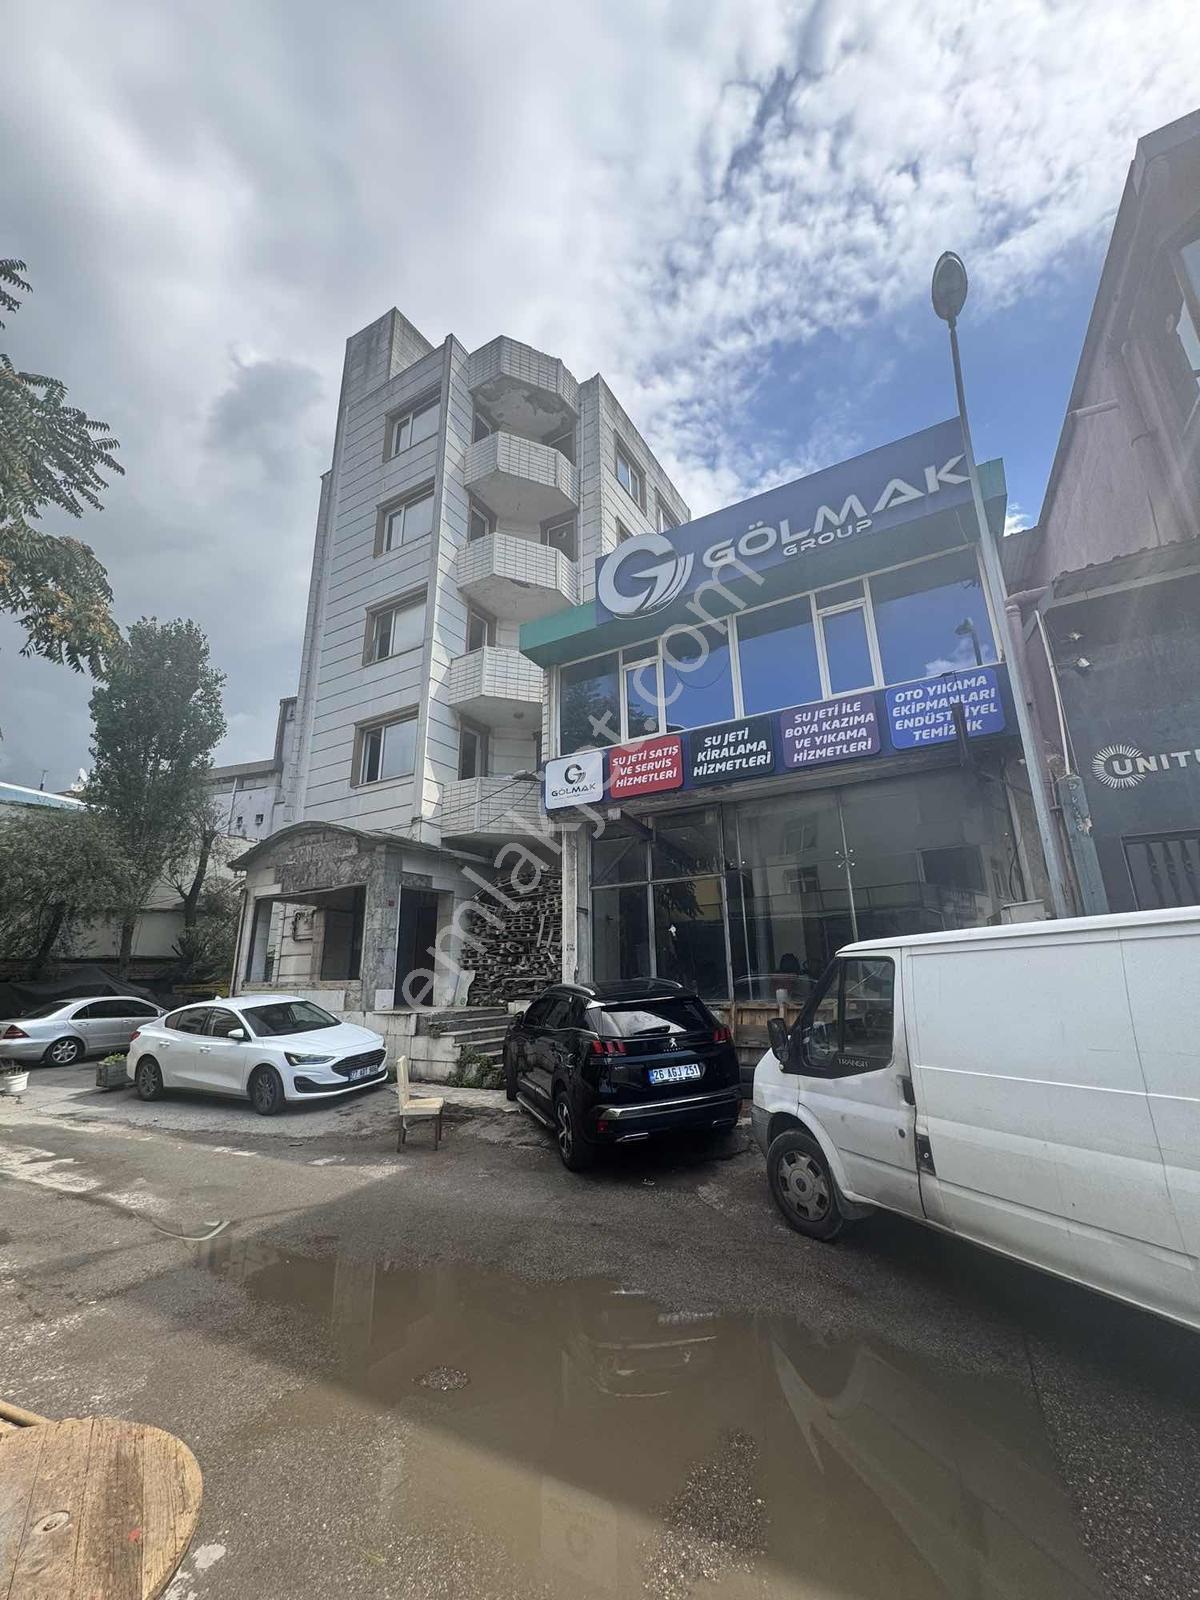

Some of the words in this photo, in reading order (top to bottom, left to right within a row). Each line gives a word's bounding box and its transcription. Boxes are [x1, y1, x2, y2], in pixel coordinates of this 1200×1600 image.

[701, 453, 971, 569] GÖLMAK
[782, 517, 874, 558] GROUP
[894, 689, 924, 703] OTO
[926, 675, 988, 697] YIKAMA
[794, 711, 812, 724] SU
[813, 703, 838, 722] JETİ
[841, 701, 862, 714] İLE
[892, 688, 996, 717] EKİPMANLARI
[784, 723, 819, 739] BOYA
[821, 712, 875, 731] KAZIMA
[895, 703, 998, 730] ENDÜSTİYEL
[703, 735, 721, 748] SU
[722, 727, 749, 746] JETİ
[794, 737, 811, 749] VE
[814, 727, 868, 746] YIKAMA
[913, 719, 984, 741] TEMİZİK
[612, 757, 626, 767] SU
[627, 751, 646, 764] JETİ
[646, 744, 679, 759] SATIŞ
[696, 740, 767, 763] KİRALAMA
[793, 737, 872, 763] HİZMETLERİ
[620, 765, 633, 776] VE
[634, 758, 672, 774] SERVİS
[693, 751, 771, 777] HİZMETLERİ
[615, 768, 677, 788] HİZMETLERİ
[653, 1069, 665, 1080] 26
[684, 1064, 699, 1076] 251
